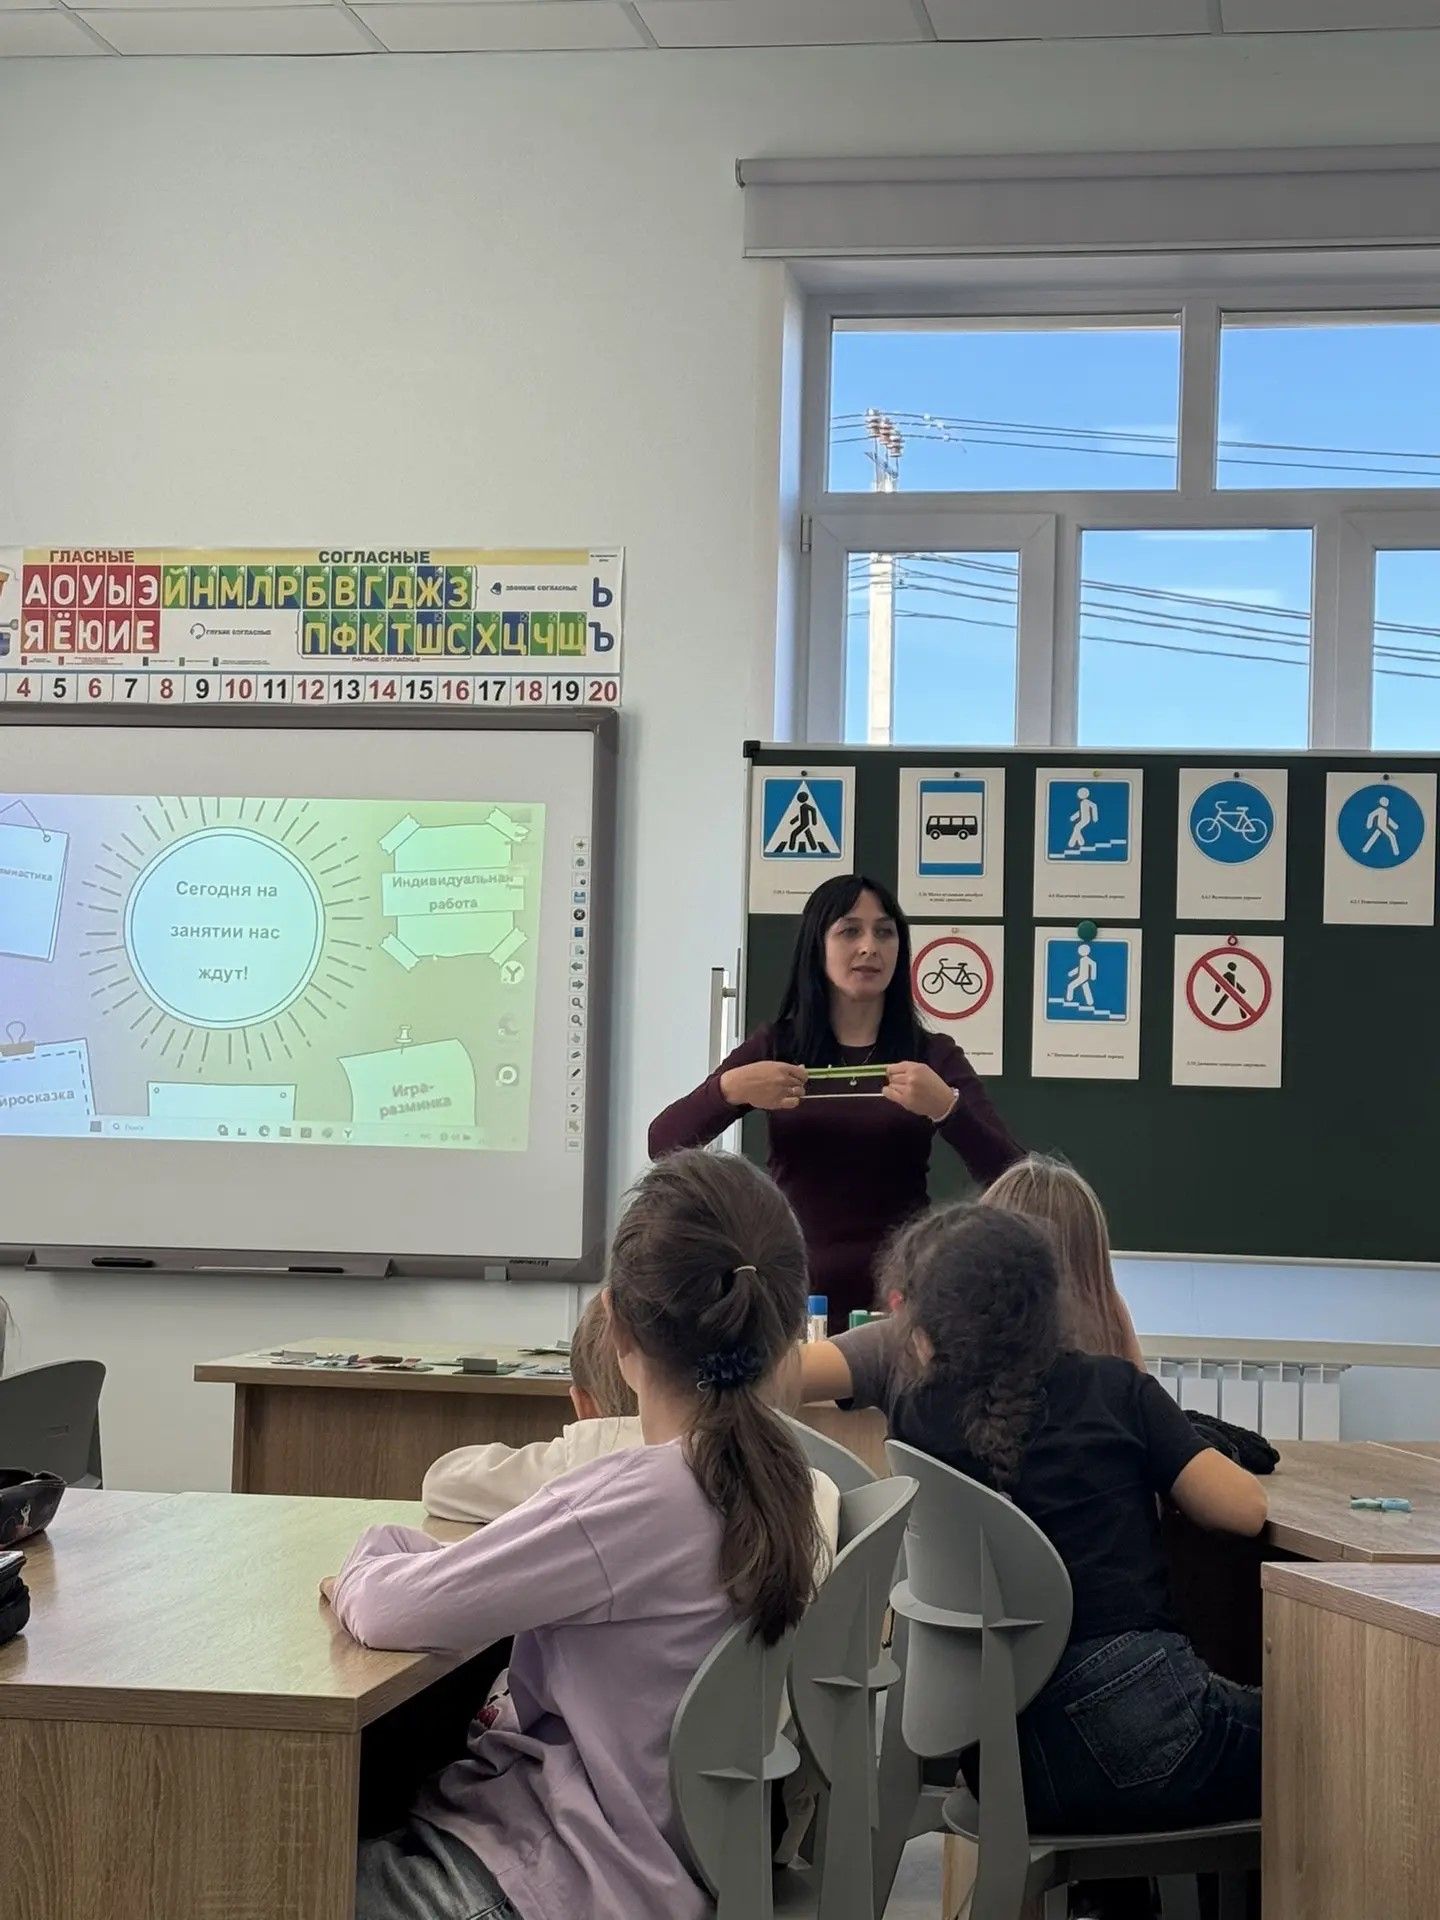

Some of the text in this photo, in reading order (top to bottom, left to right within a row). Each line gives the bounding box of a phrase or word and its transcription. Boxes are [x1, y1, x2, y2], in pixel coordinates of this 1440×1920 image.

[49, 550, 135, 564] ГЛАСНЫЕ
[318, 550, 431, 564] СОГЛАСНЫЕ
[17, 677, 618, 701] 4 5 6 7 8 9 10 11 12 13 14 15 16 17 18 19 20
[176, 880, 278, 898] Сегодня на
[429, 898, 479, 913] работа
[170, 924, 281, 940] занятии нас
[199, 966, 249, 983] ждут!
[392, 1083, 434, 1098] Игра-
[380, 1097, 452, 1120] разминка
